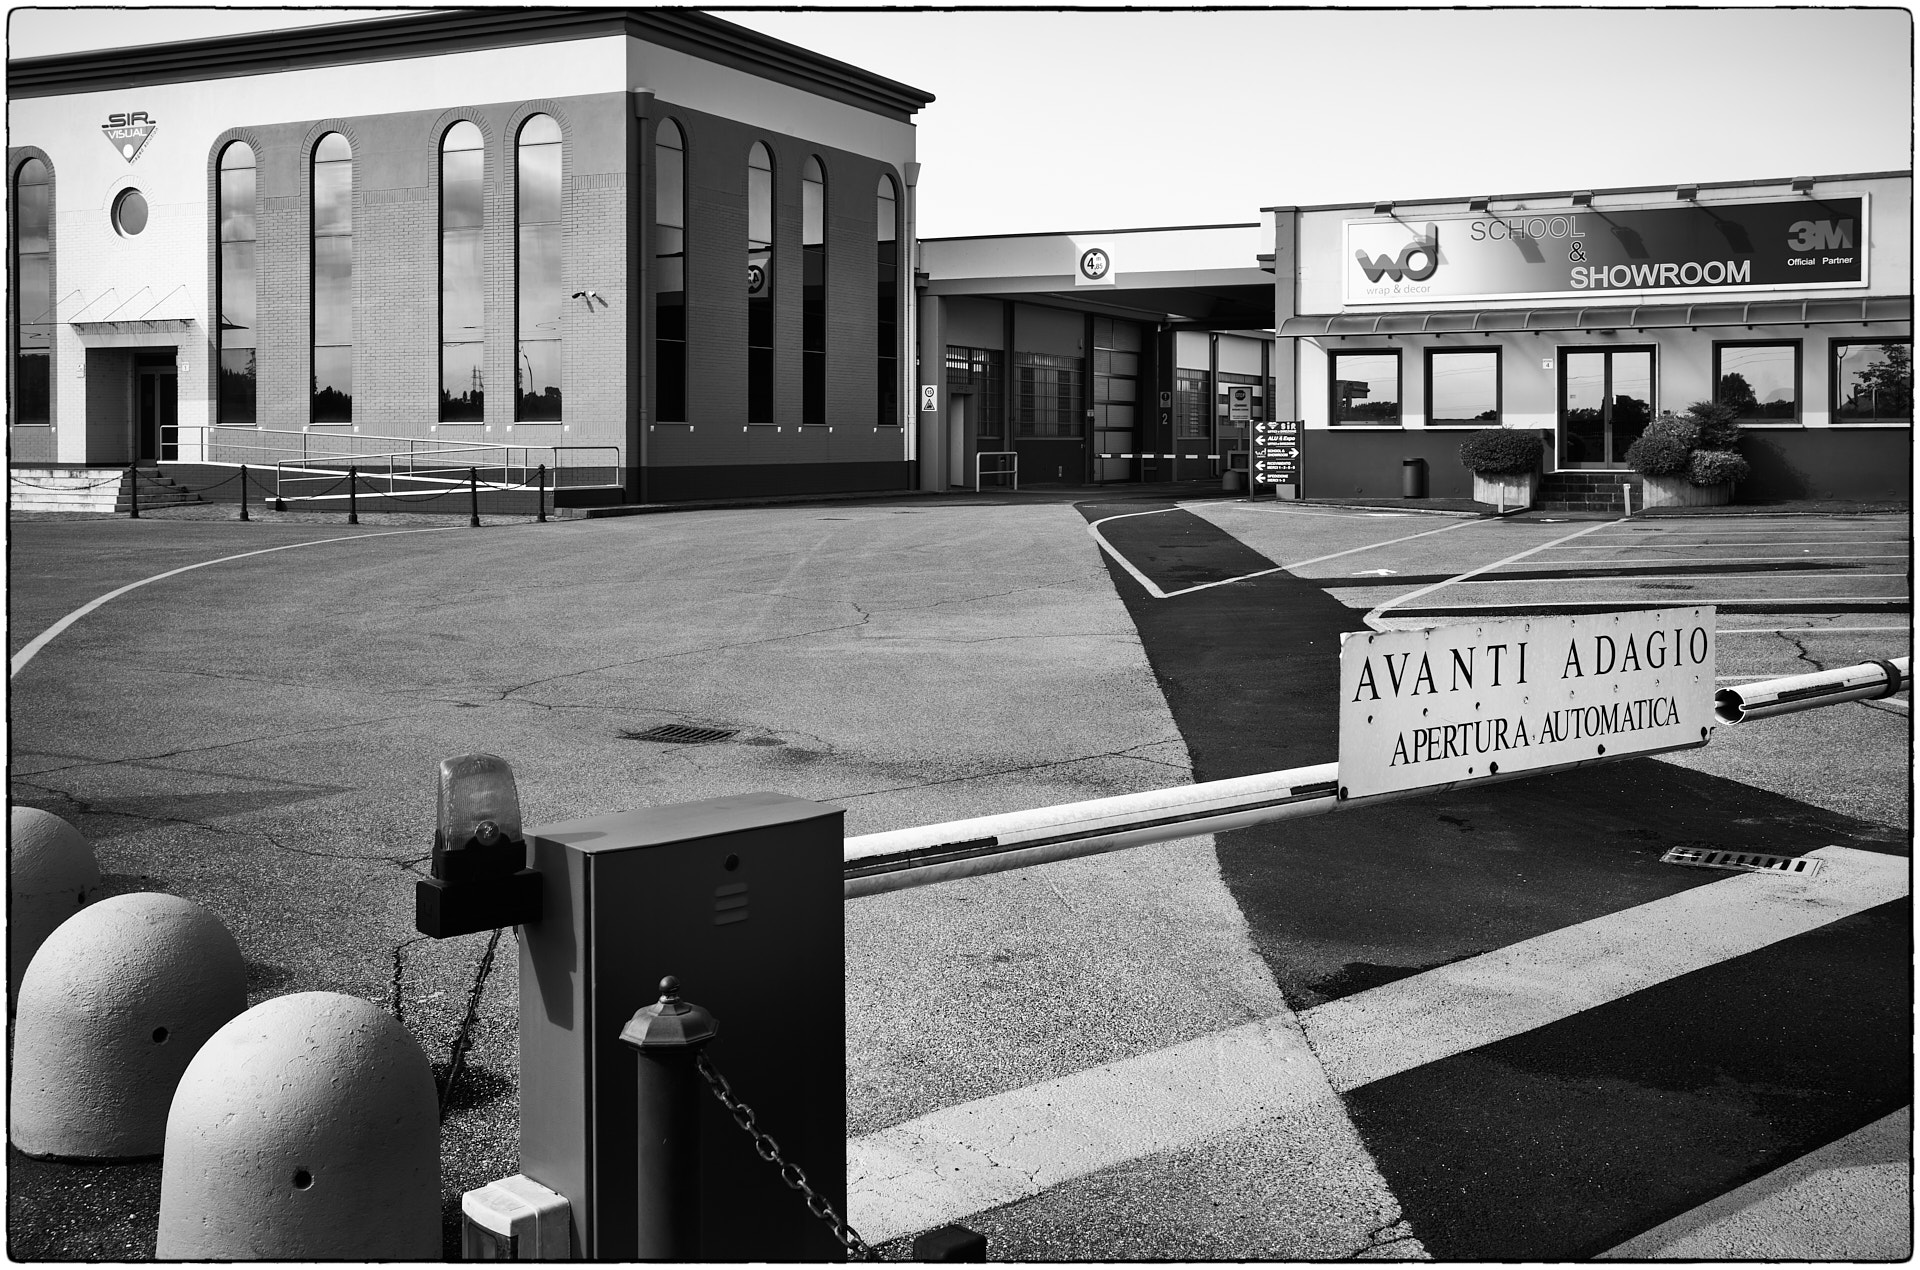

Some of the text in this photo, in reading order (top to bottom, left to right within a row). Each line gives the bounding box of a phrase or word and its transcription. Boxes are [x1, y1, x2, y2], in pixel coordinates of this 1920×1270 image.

[109, 111, 149, 128] SIR
[107, 128, 148, 139] VISUAL
[1470, 216, 1586, 241] SCHOOL
[1787, 218, 1854, 251] 3M
[1569, 241, 1586, 263] &
[1787, 256, 1854, 266] Official Partner
[1570, 260, 1751, 289] SHOWROOM
[1366, 284, 1431, 295] wrap & decor
[1162, 413, 1168, 425] 2
[1352, 627, 1708, 703] AVANTI ADAGIO
[1389, 696, 1680, 767] APERTURA AUTOMATICA
